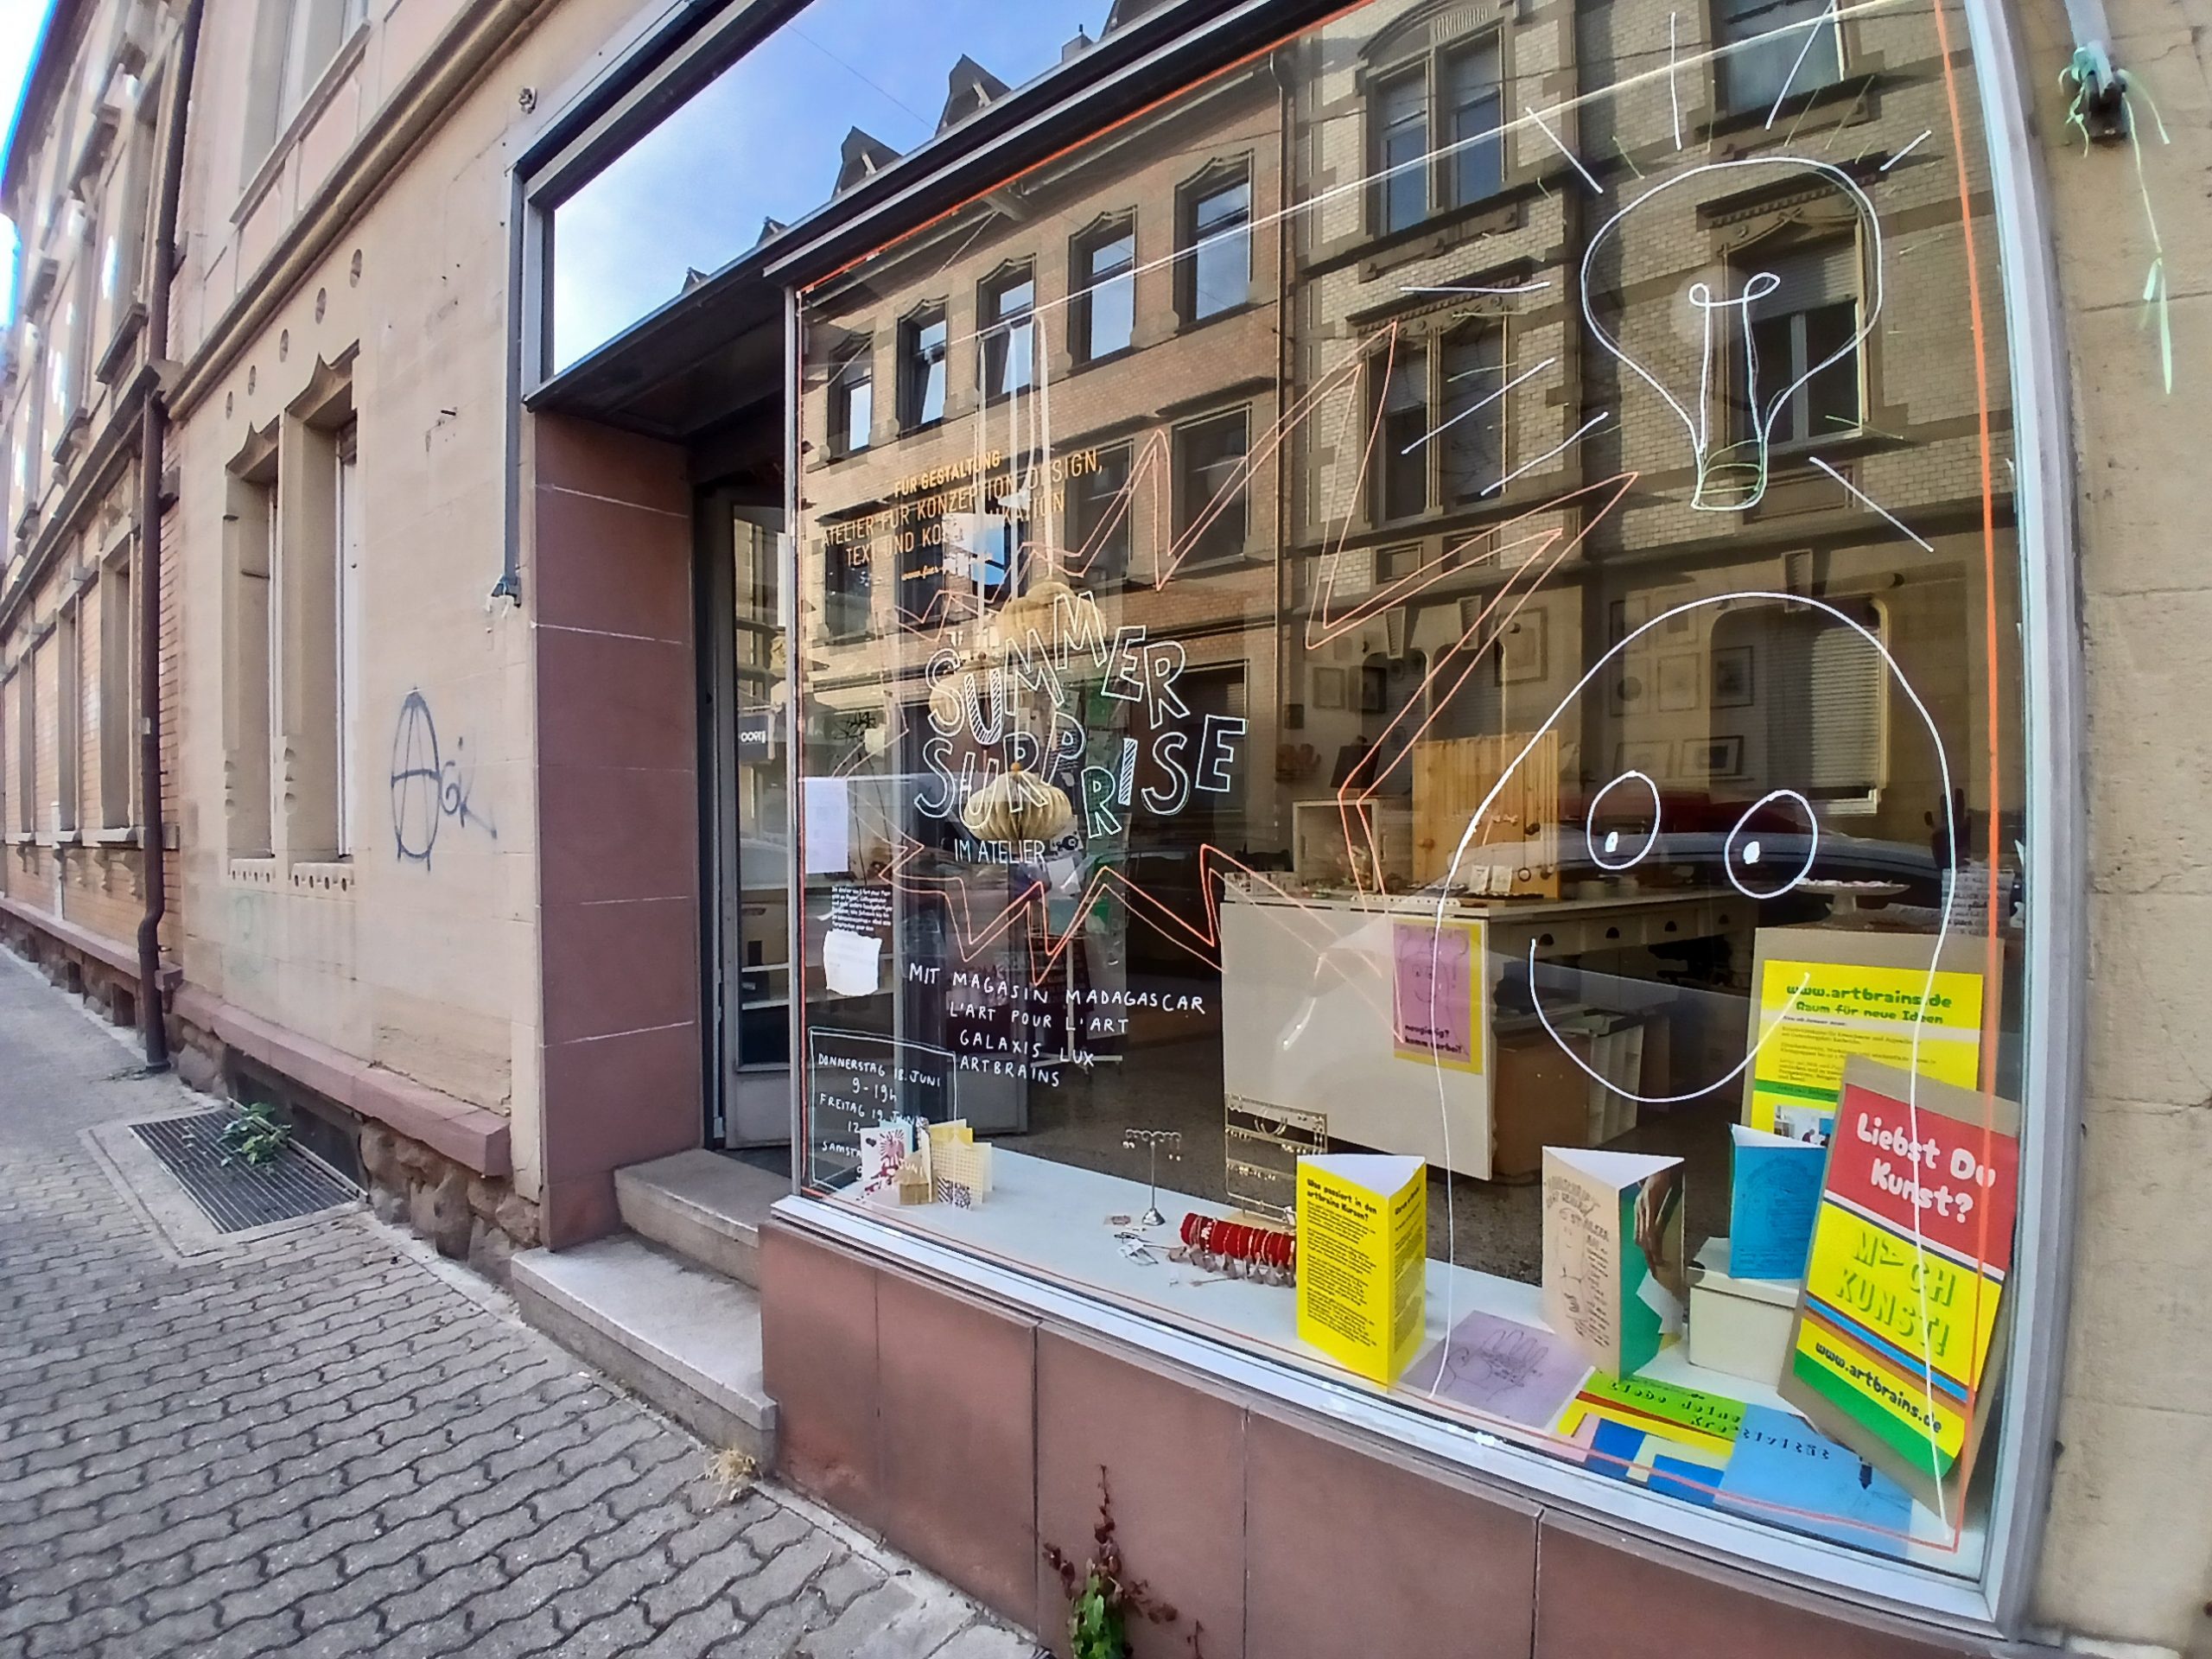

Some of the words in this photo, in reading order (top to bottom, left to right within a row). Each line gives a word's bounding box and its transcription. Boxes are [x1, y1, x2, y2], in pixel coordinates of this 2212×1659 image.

[920, 449, 1001, 490] GESTALTUNG
[822, 517, 874, 548] ATELIER
[845, 541, 876, 568] TEXT
[885, 531, 915, 557] UND
[925, 590, 1191, 746] SUMMER
[913, 711, 1247, 839] SURPRISE
[954, 839, 976, 862] IM
[977, 839, 1046, 868] ATELIER
[908, 962, 941, 985] MIT
[952, 969, 1049, 1004] MAGASIN
[1065, 988, 1206, 1015] MADAGASCAR
[950, 1000, 996, 1023] L'ART
[1010, 1009, 1053, 1031] POUR
[1065, 1015, 1129, 1034] L'ART
[1796, 1001, 1831, 1014] Raum
[1834, 1003, 1859, 1018] für
[1864, 1008, 1897, 1020] neue
[959, 1029, 1041, 1059] GALAXIS
[1059, 1046, 1095, 1068] LUX
[817, 1052, 887, 1077] DONNERSTAG
[908, 1069, 941, 1088] JUNI
[959, 1055, 1061, 1088] ARTBRAINS
[819, 1092, 866, 1118] FREITAG
[822, 1141, 863, 1159] SAMSTA
[1856, 1112, 1941, 1171] Liebst
[1949, 1147, 1997, 1189] Du
[1870, 1157, 1974, 1224] Kunst?
[1834, 1267, 1952, 1359] KUNST!
[1815, 1339, 1942, 1435] www.artbrains.de
